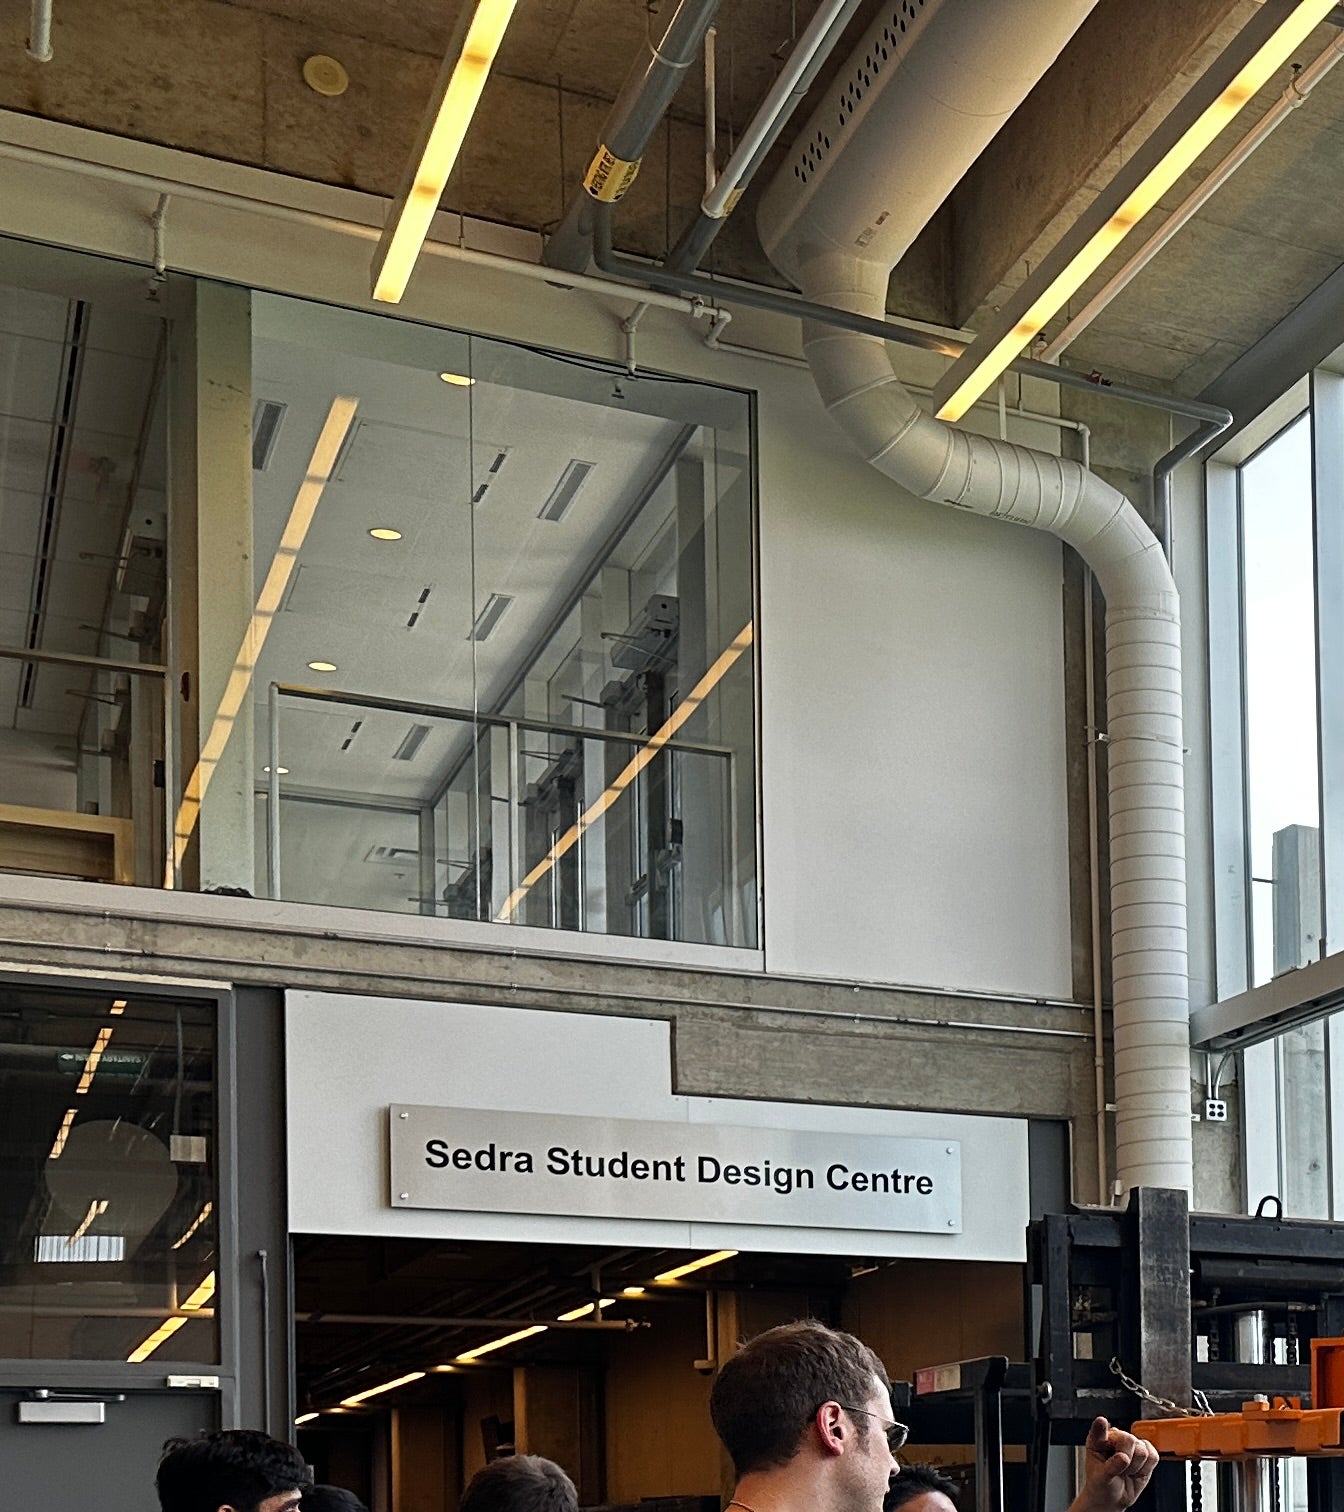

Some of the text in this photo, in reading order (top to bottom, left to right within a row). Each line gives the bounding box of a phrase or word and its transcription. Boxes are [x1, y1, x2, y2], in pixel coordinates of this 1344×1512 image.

[426, 1140, 932, 1194] Sedra Student Design Centre
